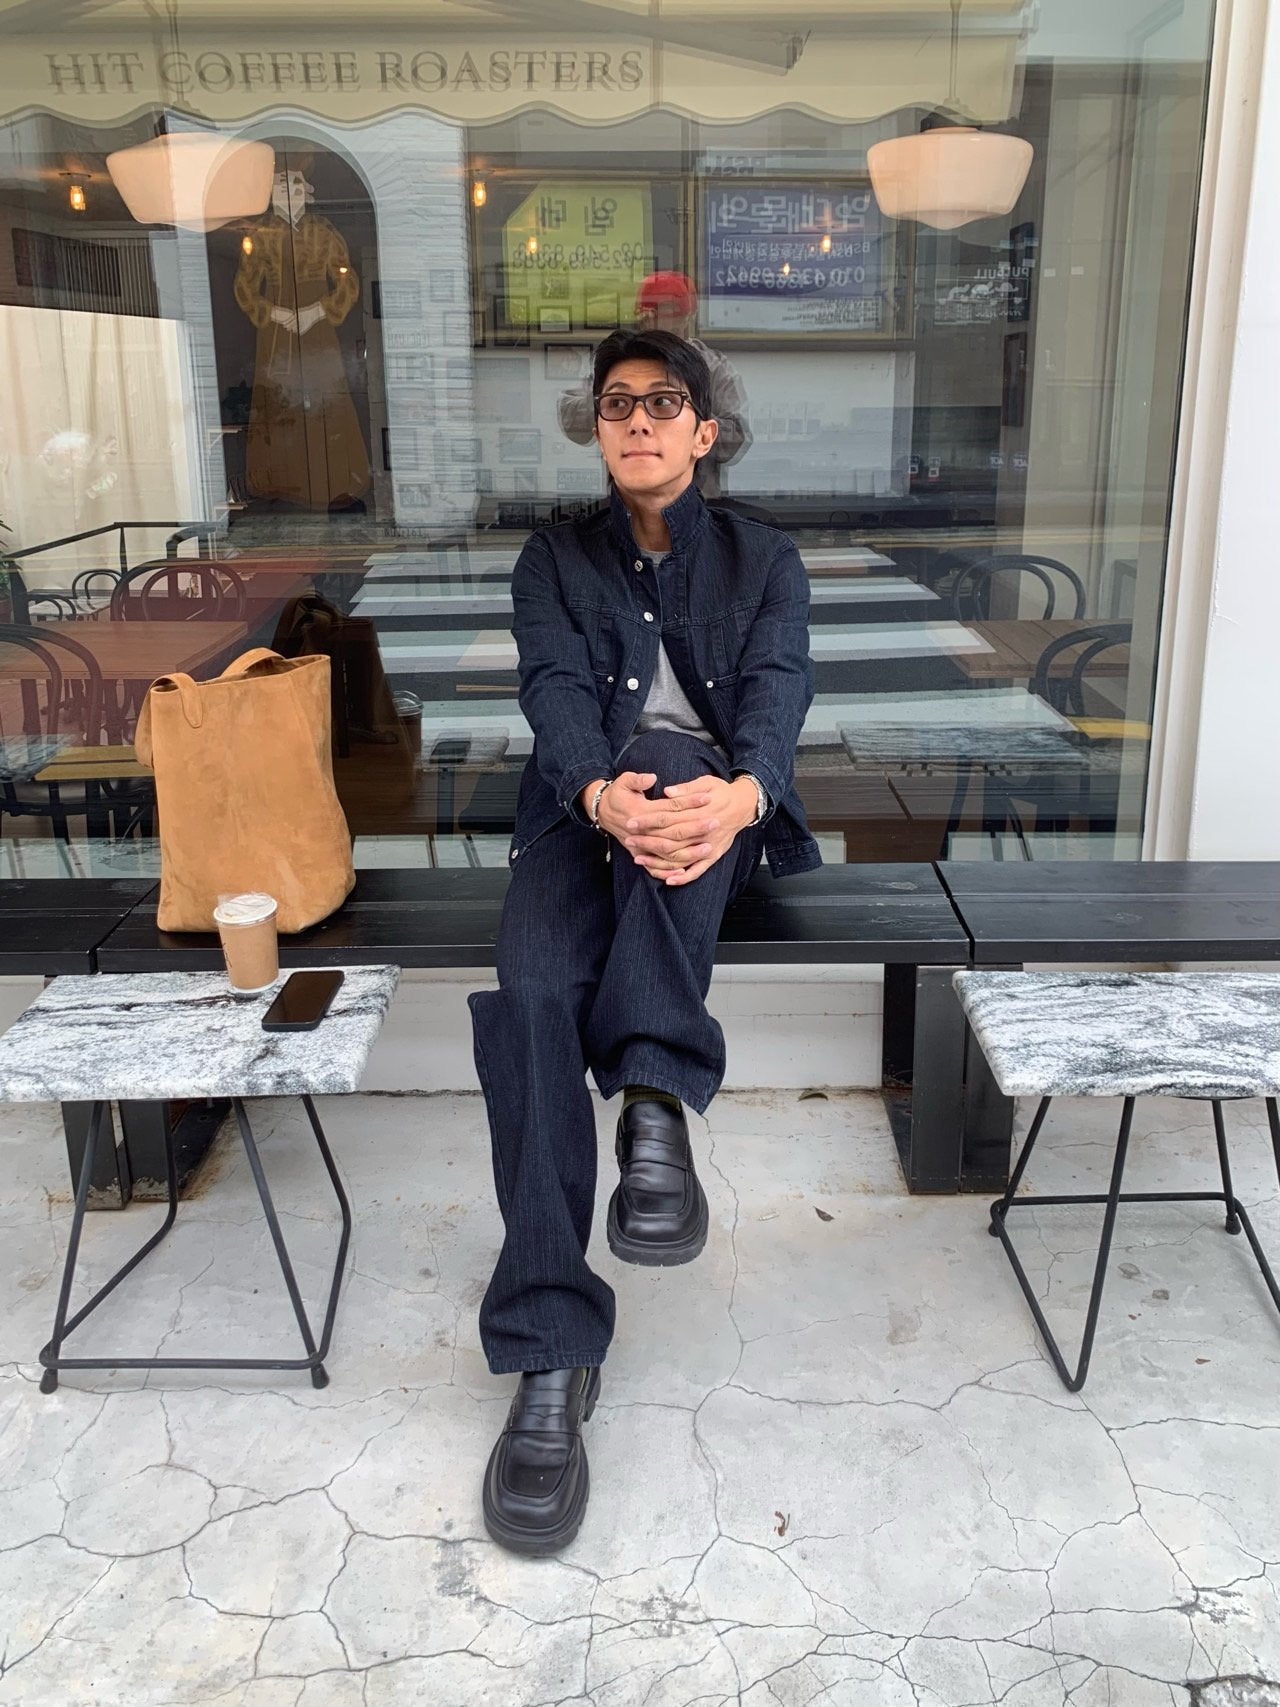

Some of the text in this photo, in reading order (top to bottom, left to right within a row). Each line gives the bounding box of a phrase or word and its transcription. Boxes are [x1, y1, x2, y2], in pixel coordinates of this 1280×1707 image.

[44, 50, 644, 95] HIT COFFEE ROASTERS
